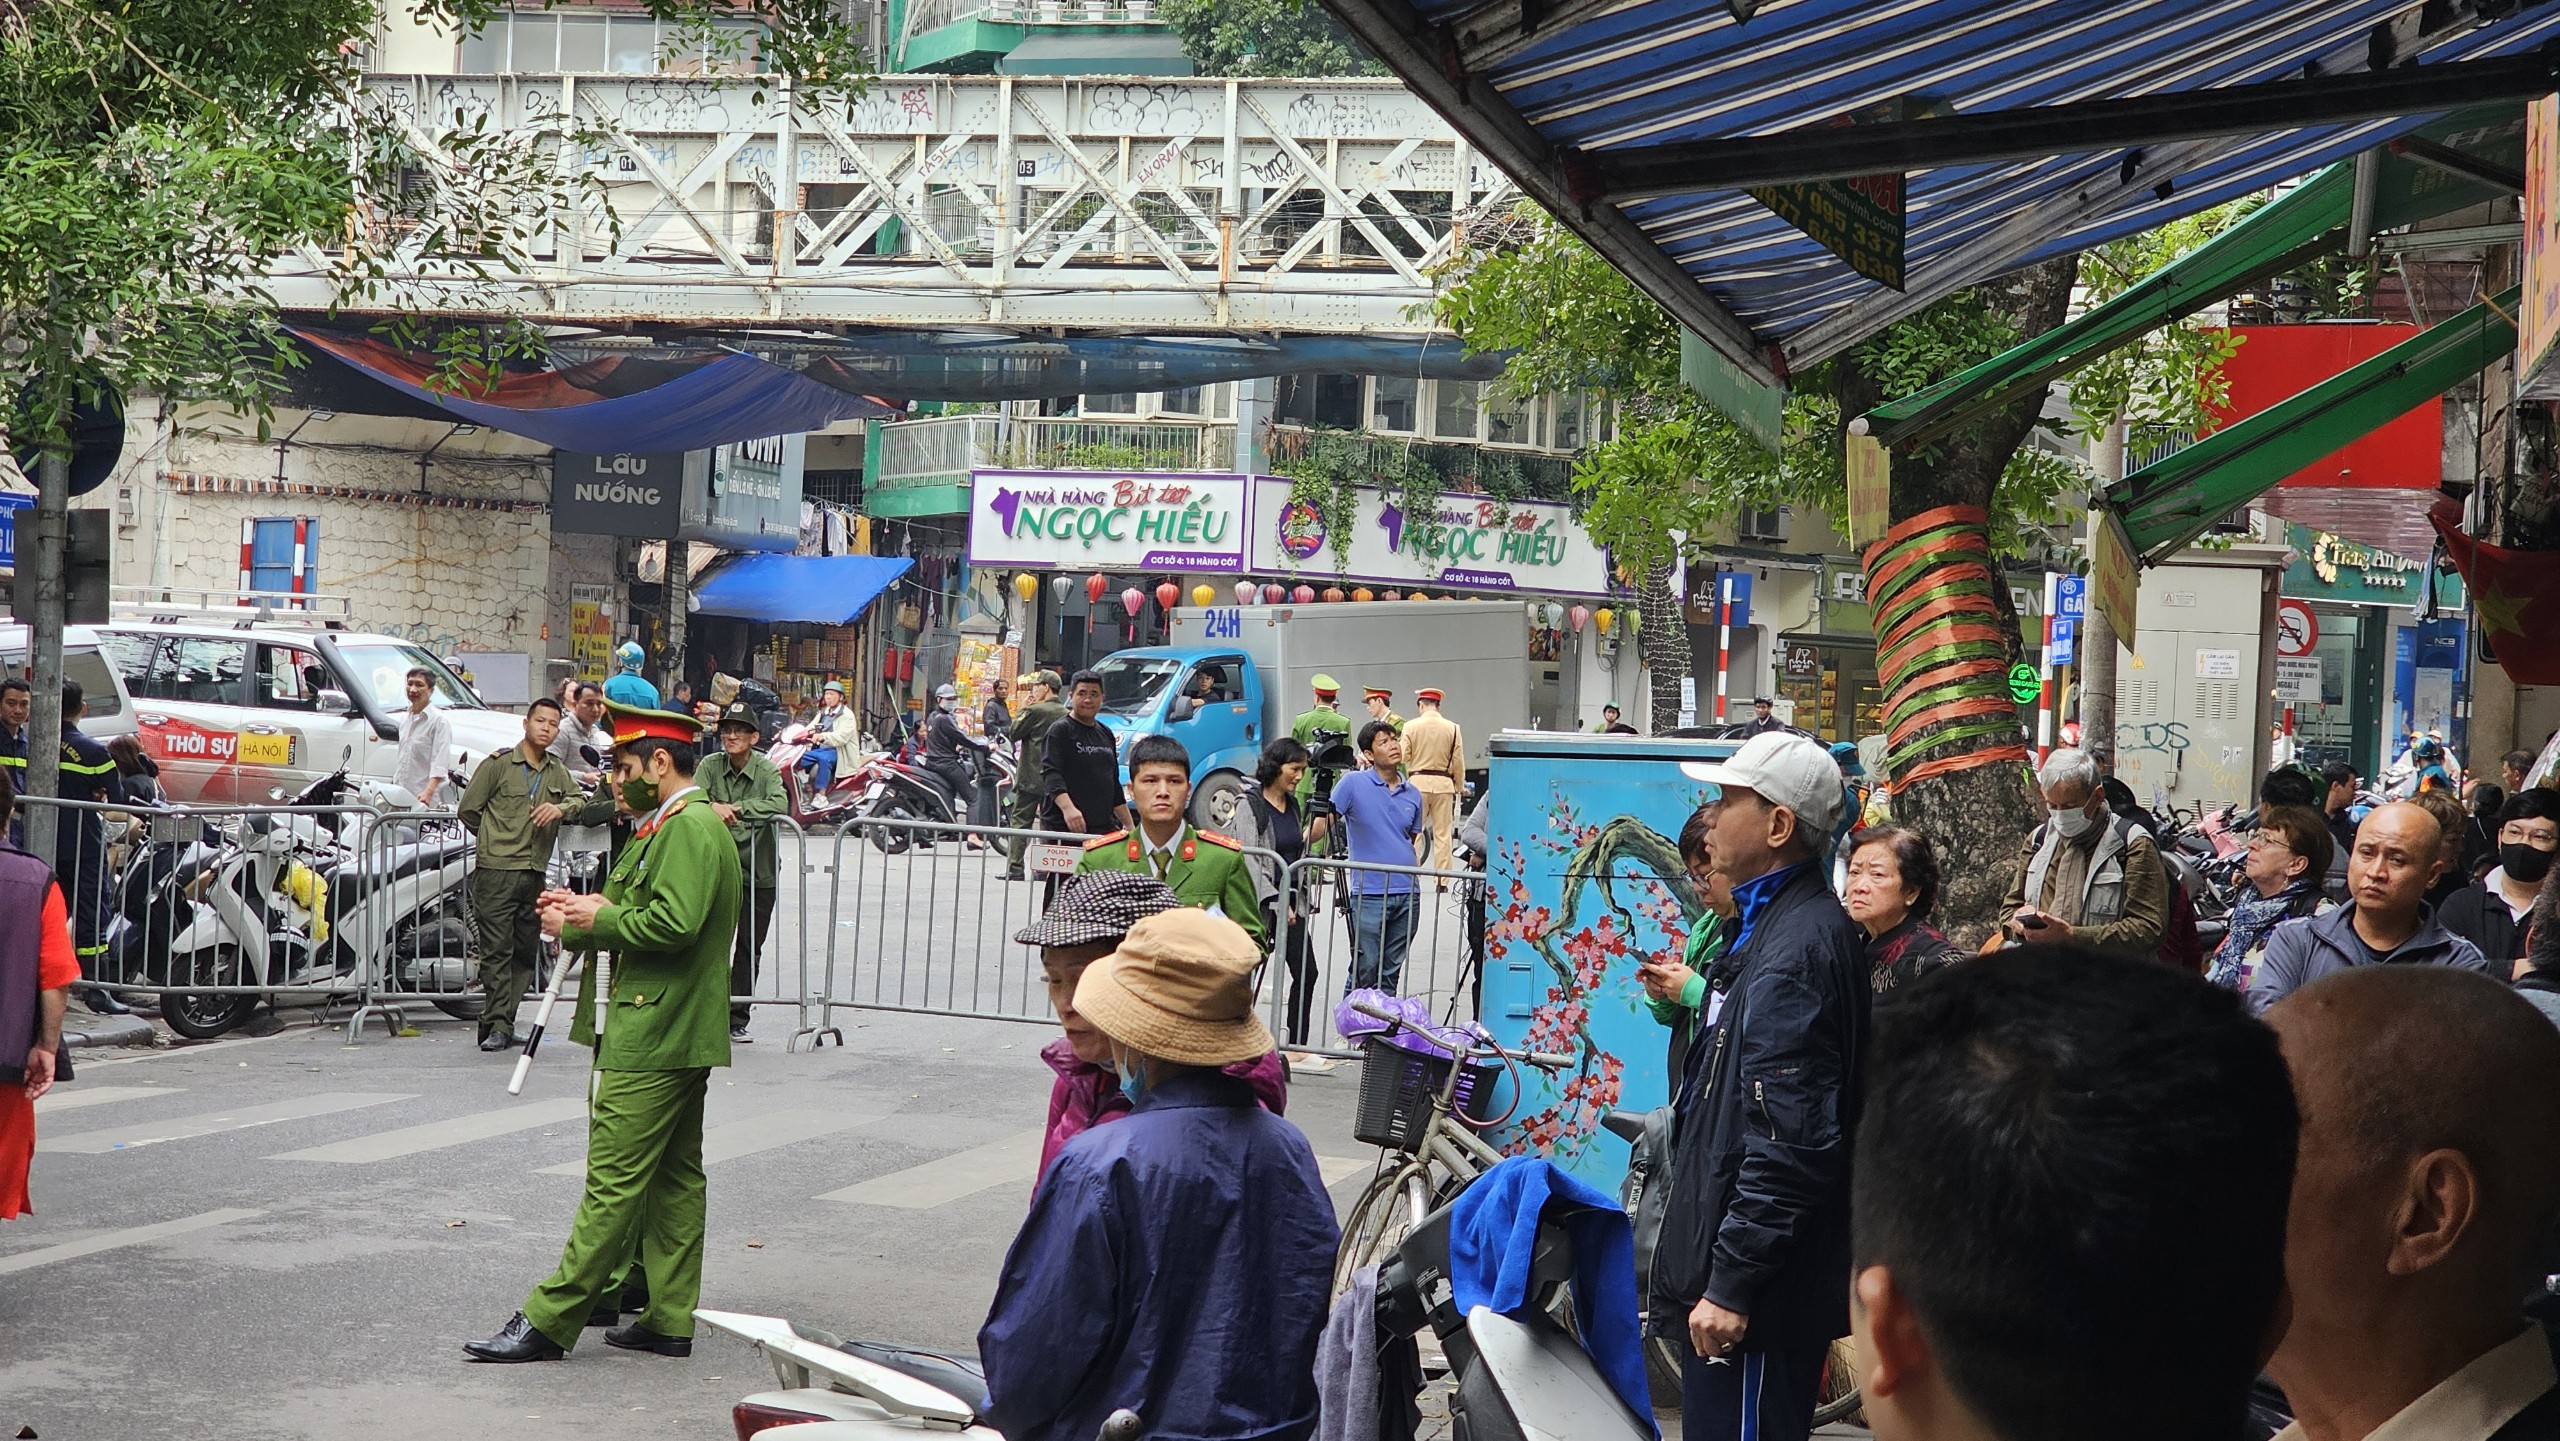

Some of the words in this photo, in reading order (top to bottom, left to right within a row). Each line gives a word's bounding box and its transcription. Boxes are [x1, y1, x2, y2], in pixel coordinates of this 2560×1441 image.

[619, 155, 634, 171] 01
[1018, 161, 1035, 175] 03
[1809, 191, 1848, 234] 995
[1852, 222, 1898, 260] 337
[1853, 249, 1898, 287] 638
[575, 479, 661, 506] NƯỚNG
[1023, 486, 1057, 506] NHÀ
[1061, 486, 1108, 506] HÀNG
[1016, 506, 1131, 549] NGỌC
[1136, 493, 1230, 543] HIẾU
[1399, 522, 1490, 568] NGỌC
[1495, 518, 1568, 567] HIẾU
[1150, 555, 1164, 565] CƠ
[1165, 555, 1177, 565] SỞ
[1177, 556, 1185, 566] 4:
[1186, 557, 1196, 566] 18
[1197, 555, 1220, 567] HÀNG
[1220, 556, 1238, 567] CÓT
[2371, 549, 2394, 569] An
[1205, 609, 1242, 640] 24H
[2434, 637, 2456, 645] NCB
[165, 731, 206, 755] THỜI
[211, 736, 237, 760] SỰ
[243, 741, 260, 756] HÀ
[261, 742, 283, 758] NỘI
[1047, 848, 1069, 856] POLICE
[1042, 857, 1073, 868] STOP
